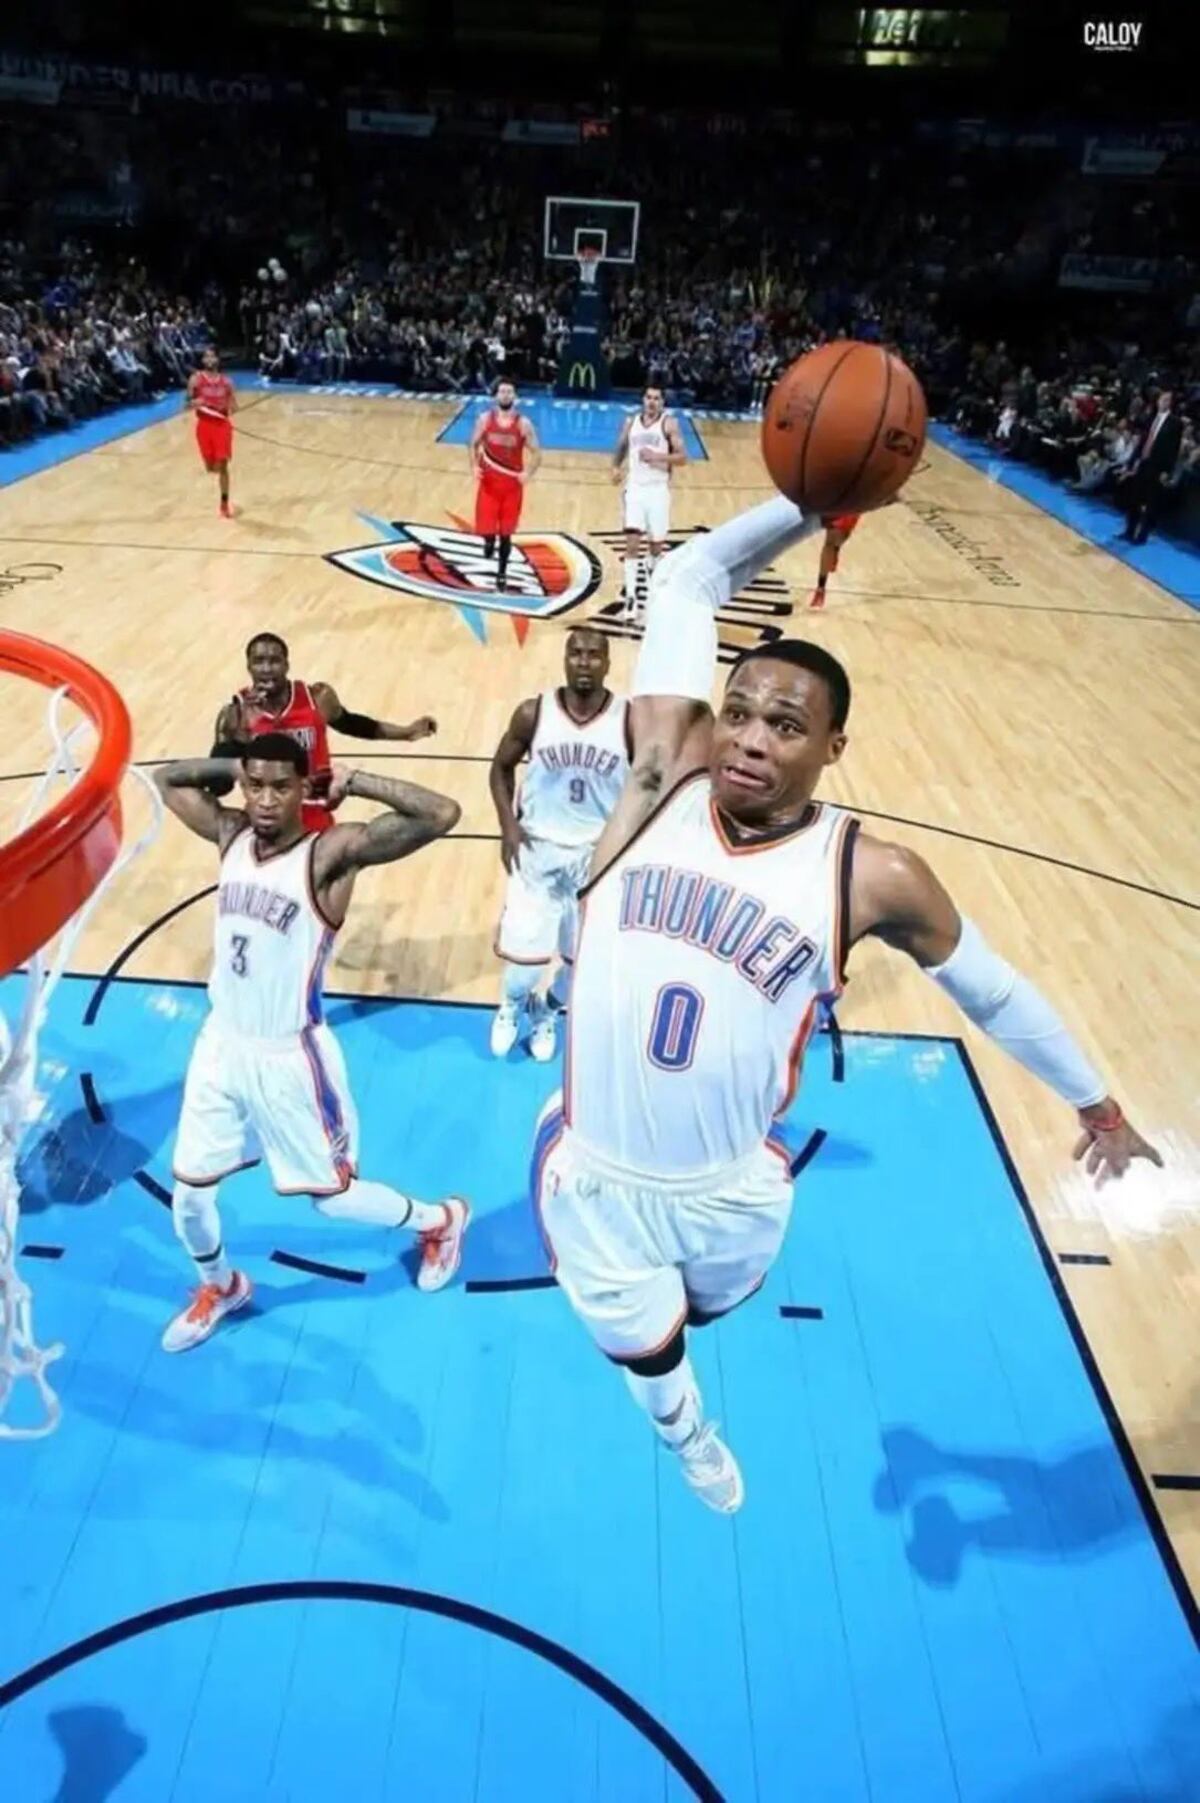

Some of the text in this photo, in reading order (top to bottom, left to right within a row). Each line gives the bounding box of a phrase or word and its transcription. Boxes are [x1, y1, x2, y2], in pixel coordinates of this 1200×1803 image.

[538, 743, 620, 778] THUNDER
[569, 778, 586, 804] 9
[231, 934, 249, 977] 3
[619, 864, 819, 1004] THUNDER
[647, 982, 704, 1072] 0
